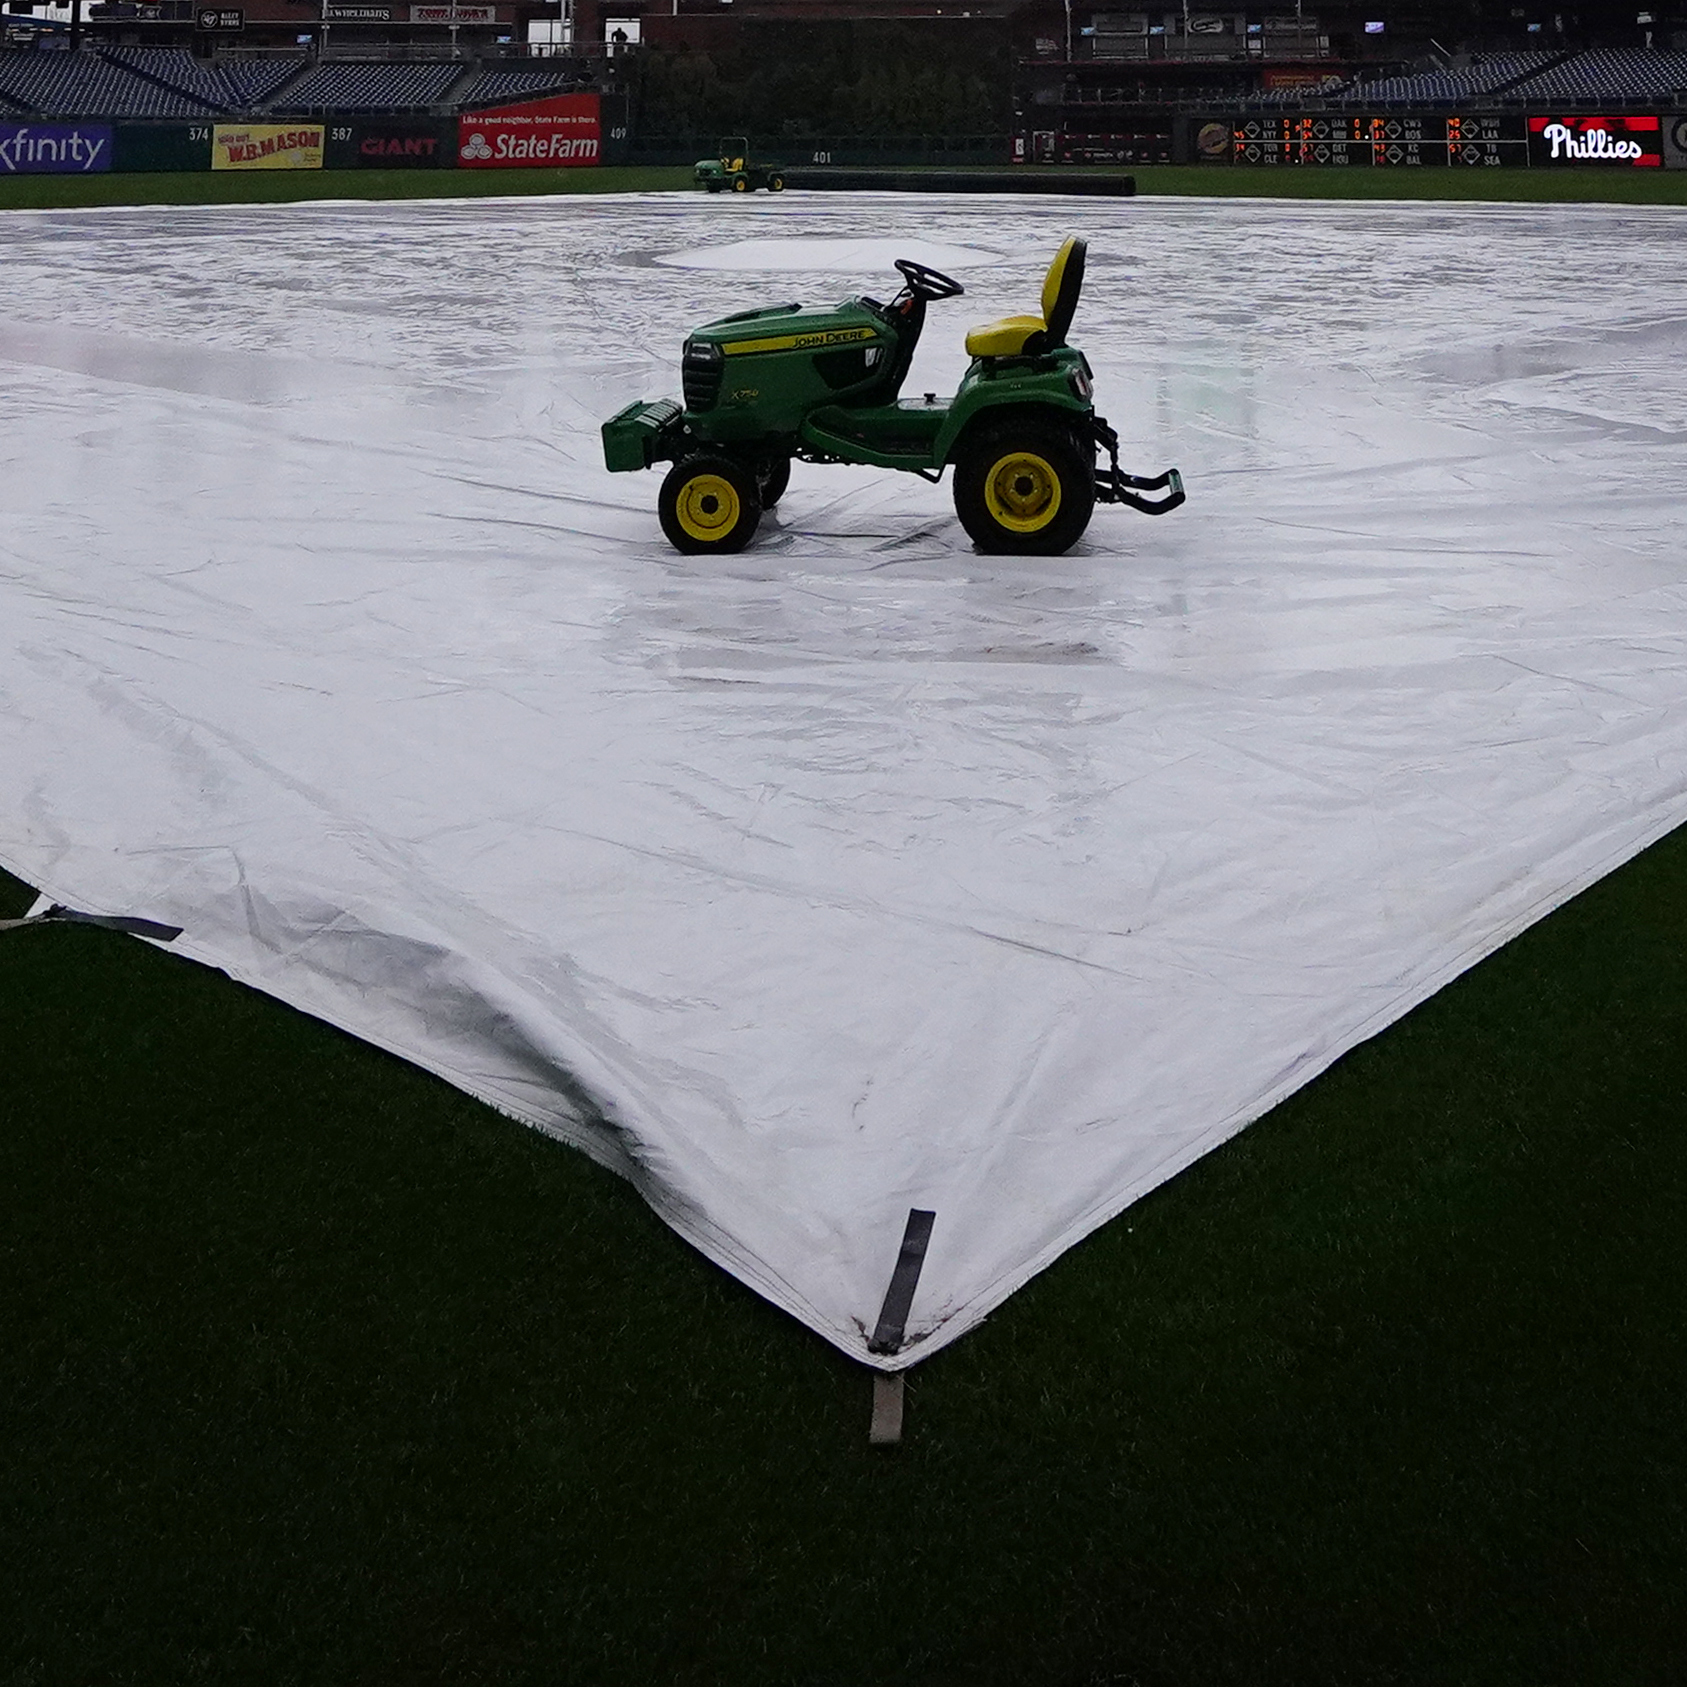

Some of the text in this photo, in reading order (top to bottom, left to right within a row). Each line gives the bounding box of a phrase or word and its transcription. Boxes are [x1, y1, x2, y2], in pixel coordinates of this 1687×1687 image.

[188, 128, 209, 141] 374
[331, 128, 353, 142] 387
[610, 127, 627, 140] 409
[360, 138, 438, 156] GIANT
[1543, 123, 1643, 159] Phillies
[812, 151, 832, 164] 401
[792, 330, 865, 349] JOHN DEERE
